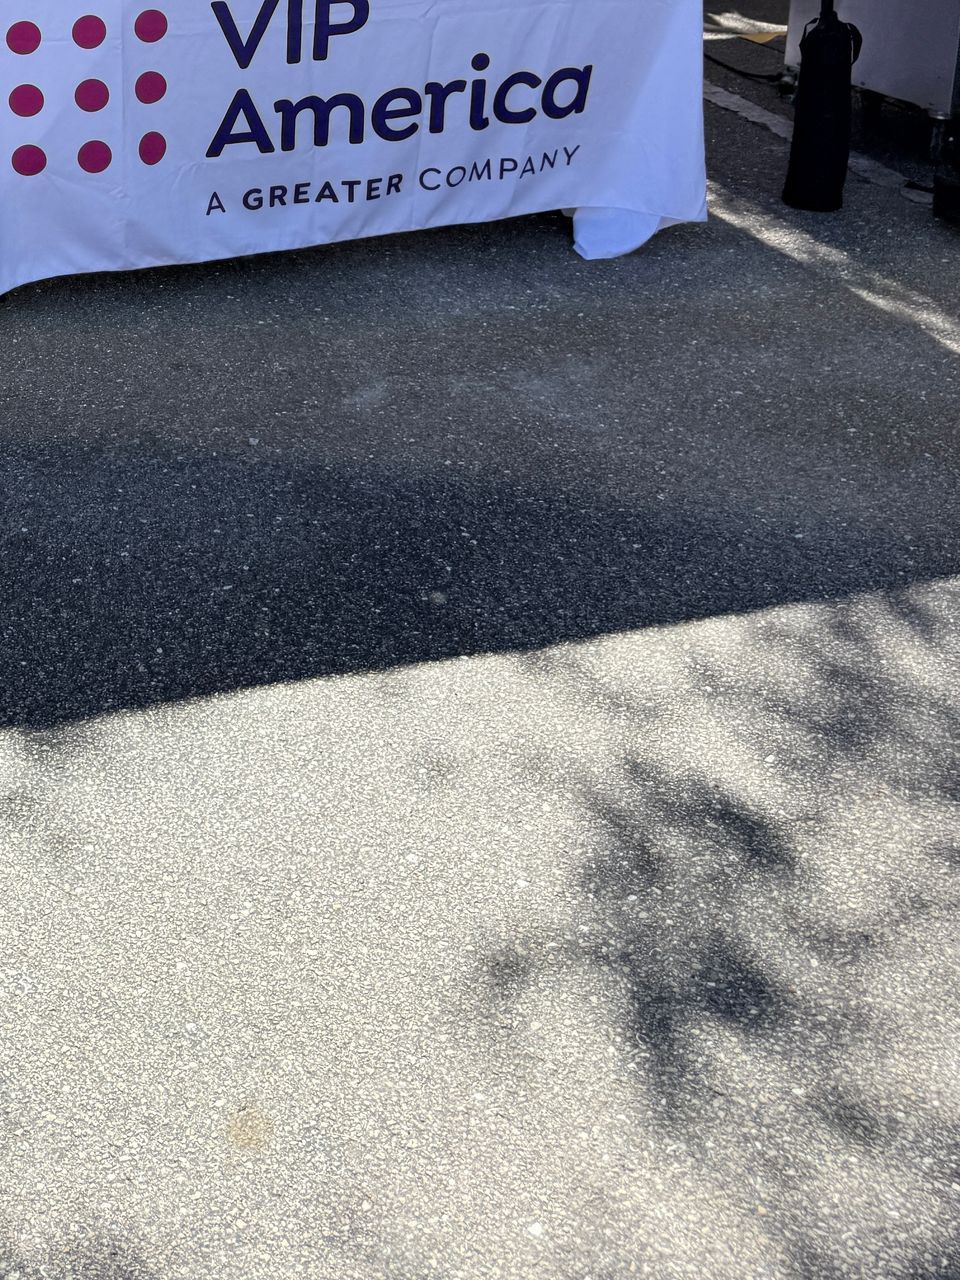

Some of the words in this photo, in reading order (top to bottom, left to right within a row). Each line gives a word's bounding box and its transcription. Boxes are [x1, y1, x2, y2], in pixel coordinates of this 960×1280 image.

[205, 53, 593, 158] America
[206, 191, 226, 216] A
[242, 173, 404, 211] GREATER
[419, 144, 581, 191] COMPANY
